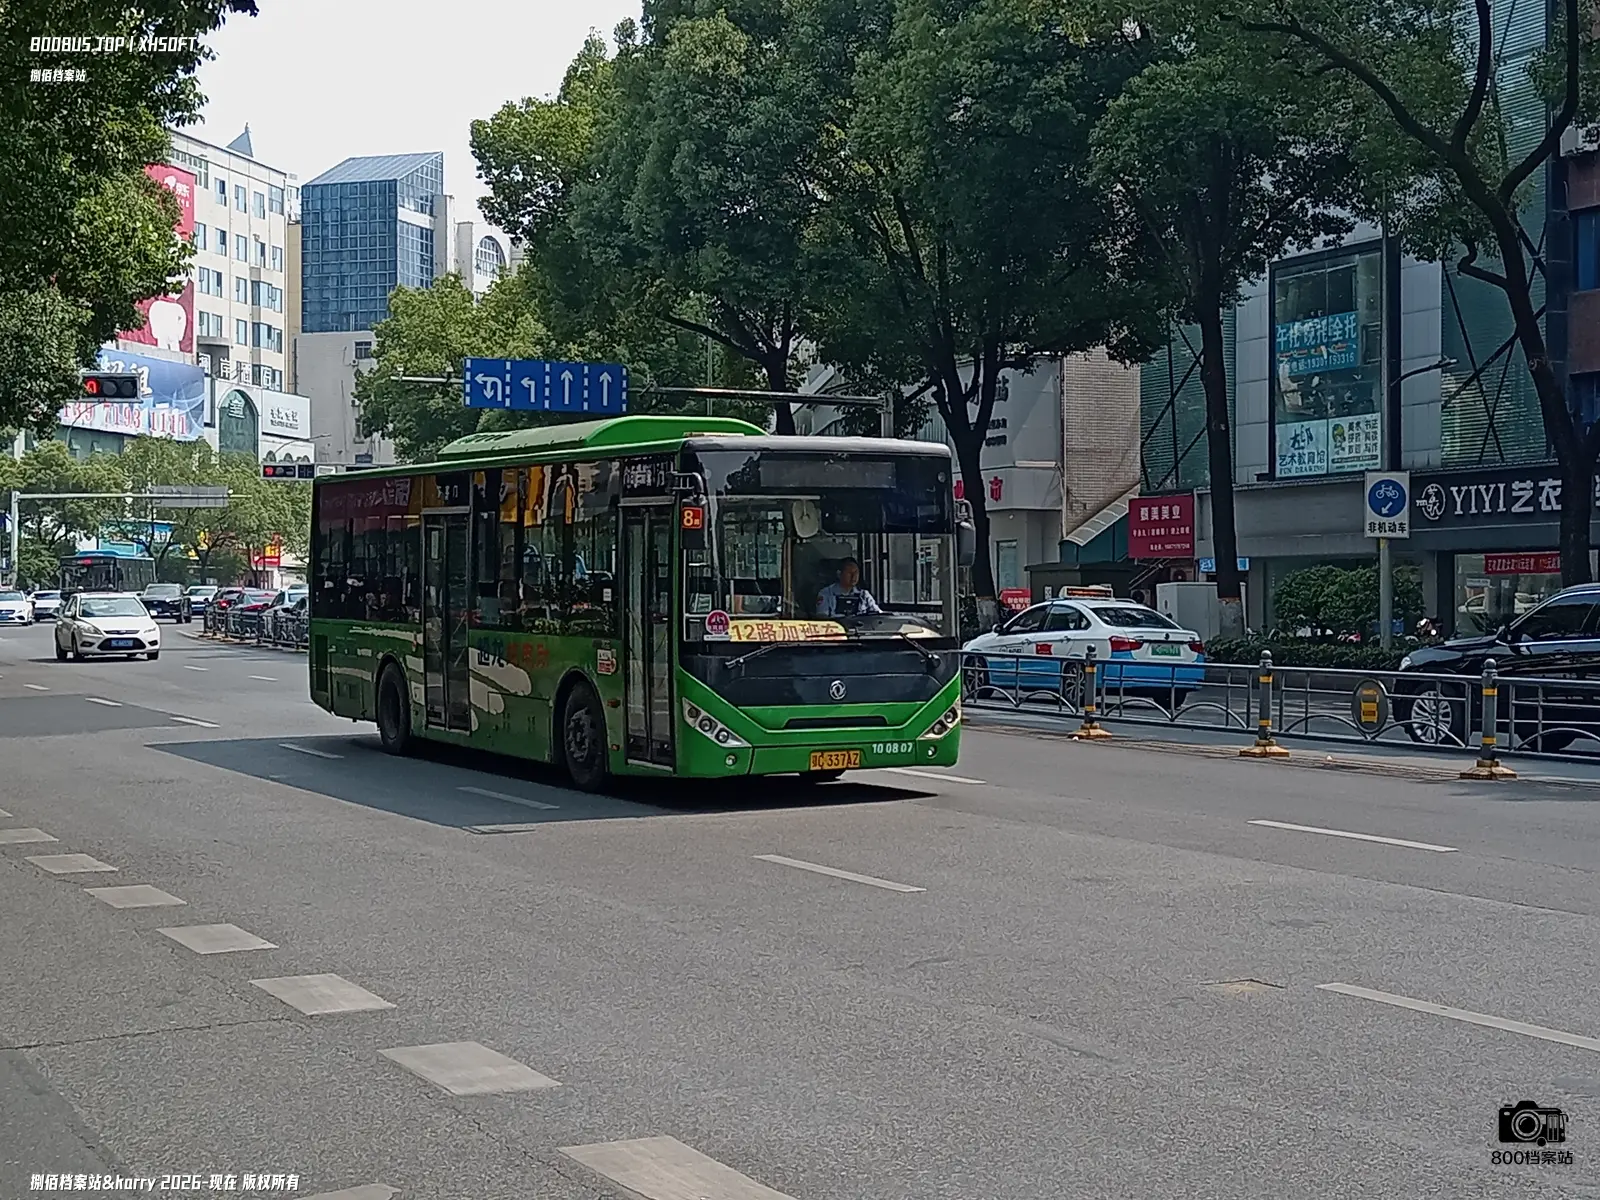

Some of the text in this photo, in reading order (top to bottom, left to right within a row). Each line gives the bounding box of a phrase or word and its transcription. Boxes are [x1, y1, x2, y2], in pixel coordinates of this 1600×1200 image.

[103, 402, 141, 428] 7193
[150, 411, 187, 435] 1111
[1278, 450, 1326, 467] 艺术教育馆
[1511, 478, 1562, 513] 艺衣
[1368, 521, 1407, 534] 非机动车
